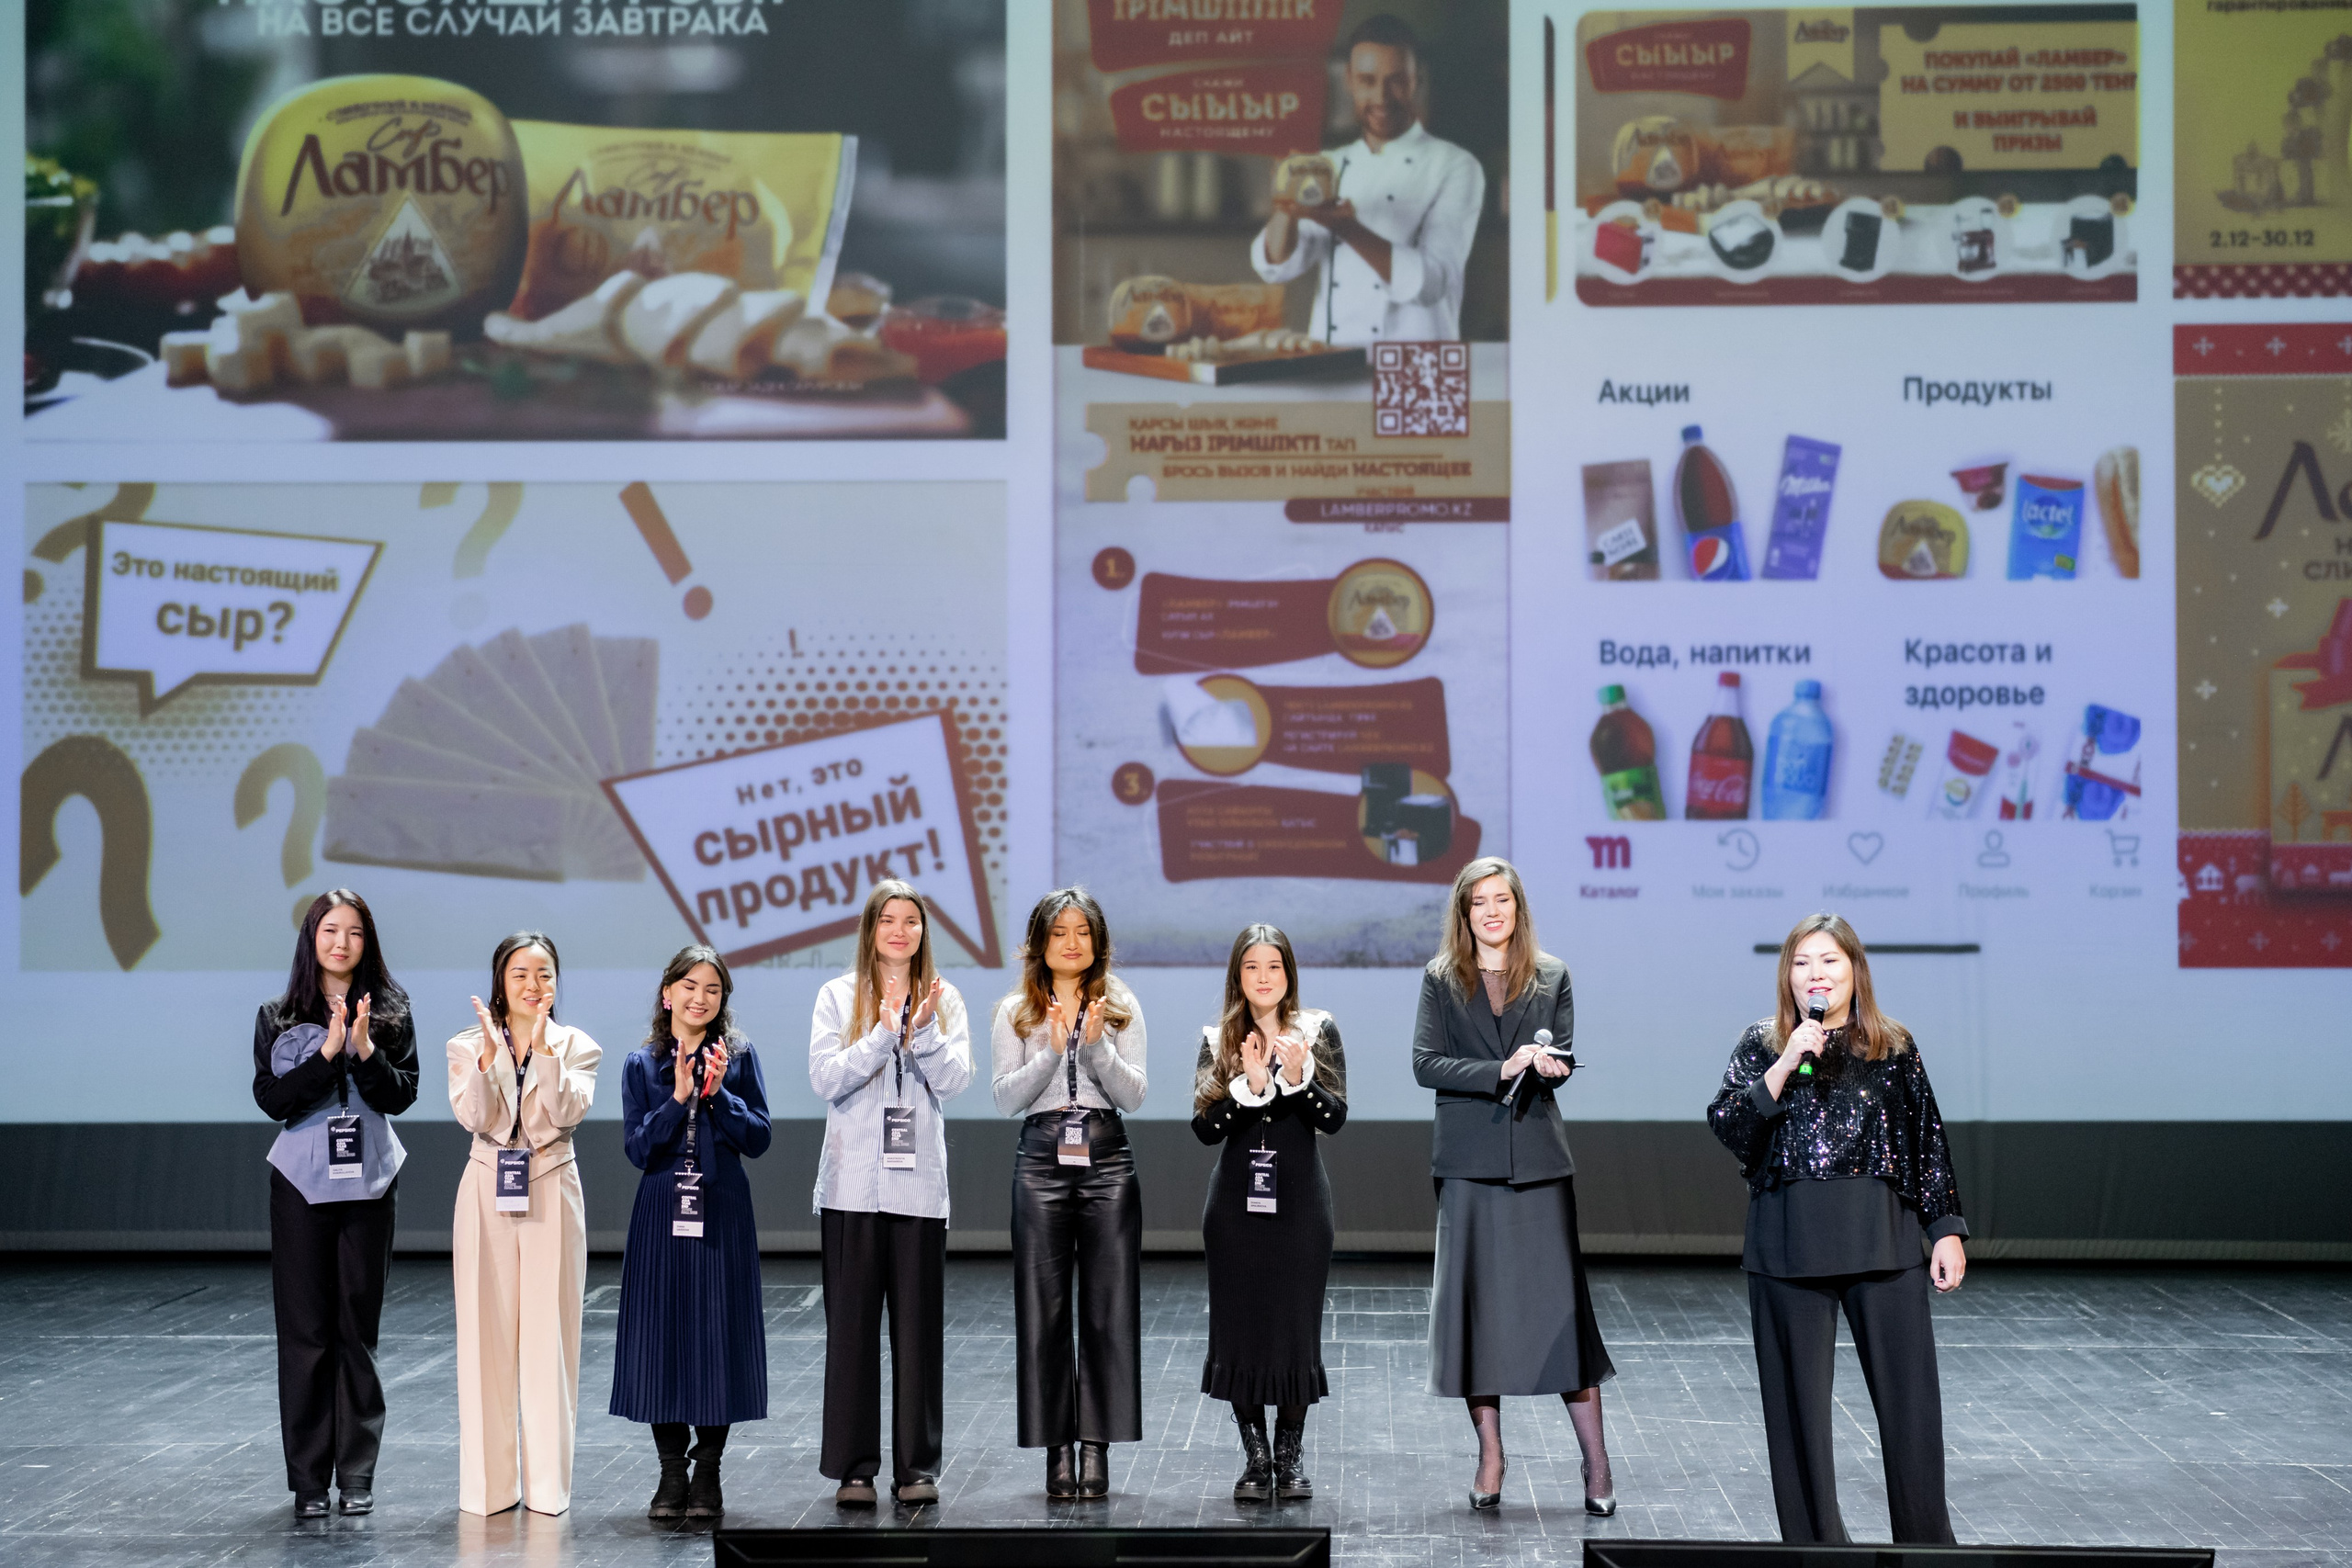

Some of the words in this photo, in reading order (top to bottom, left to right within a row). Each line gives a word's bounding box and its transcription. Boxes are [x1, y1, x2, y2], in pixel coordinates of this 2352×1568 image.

[257, 8, 310, 36] НА
[322, 8, 394, 36] ВСЕ
[572, 8, 768, 36] ЗАВТРАКА
[1168, 30, 1208, 46] ДЕП
[1216, 29, 1254, 44] АЙТ
[1615, 42, 1735, 67] СЫЫЫР
[1925, 47, 2020, 69] ПОКУПАЙ
[2025, 49, 2127, 68] «ЛАМБЕР»
[1901, 75, 1928, 94] НА
[1932, 74, 2005, 94] СУММУ
[2007, 73, 2037, 93] ОТ
[1140, 92, 1300, 121] СЫЫЫР
[1953, 110, 1969, 129] И
[1973, 105, 2098, 129] ВЫИГРЫВАЙ
[1993, 132, 2063, 152] ПРИЗЫ
[280, 134, 510, 217] Ламбер
[551, 167, 760, 241] Ламбер
[1599, 378, 1690, 409] Акции
[1903, 377, 2052, 408] Продукты
[1275, 463, 1287, 478] И
[1291, 461, 1349, 479] НАЙДИ
[1352, 461, 1472, 479] НАСТОЯЩЕЕ
[1320, 502, 1474, 518] LAMBERPROMO.KZ
[111, 552, 165, 580] Это
[174, 561, 340, 593] настоящий
[156, 601, 296, 652] сыр?
[1599, 639, 1678, 669] Вода,
[1690, 641, 1811, 665] напитки
[1905, 638, 2028, 669] Красота
[2035, 643, 2052, 663] и
[1905, 683, 2045, 709] здоровье
[736, 779, 803, 807] Нет,
[811, 757, 864, 787] это
[694, 773, 923, 866] сырный
[695, 829, 945, 929] продукт!
[1580, 883, 1640, 900] Каталог
[1823, 882, 1910, 899] Избранное
[1959, 882, 2030, 901] Профиль
